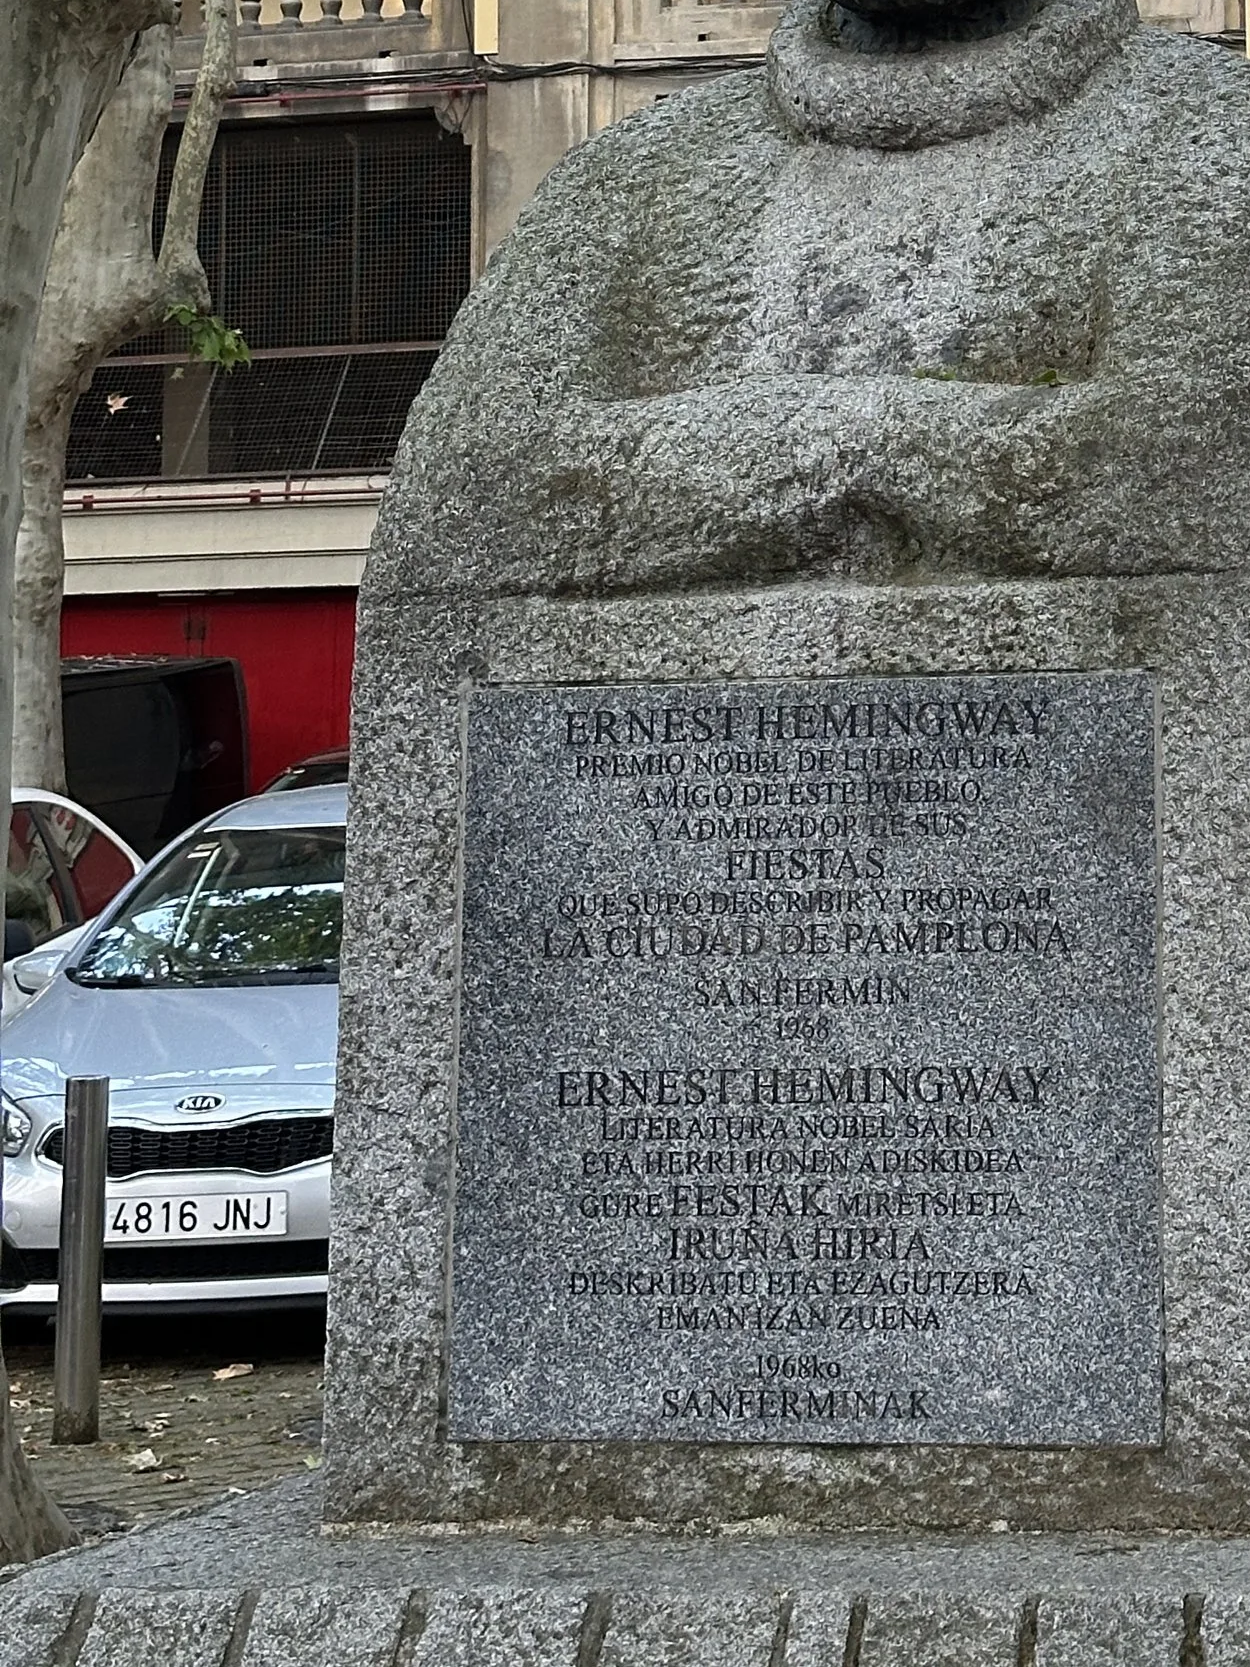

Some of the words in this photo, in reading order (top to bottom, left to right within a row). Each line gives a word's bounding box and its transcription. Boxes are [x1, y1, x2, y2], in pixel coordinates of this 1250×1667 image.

[565, 707, 743, 745] ERNEST
[755, 700, 1050, 741] HEMINGWAY
[575, 752, 686, 778] PREMIO
[694, 750, 789, 775] NOBEL
[798, 749, 834, 773] DE
[842, 746, 1032, 771] LITERATURA
[632, 784, 734, 809] AMIGO
[743, 784, 780, 806] DE
[788, 782, 856, 805] ESTE
[648, 818, 664, 841] Y
[675, 815, 857, 841] ADMIRADOR
[914, 811, 971, 837] SUS
[726, 848, 886, 881] FIESTAS
[558, 893, 620, 921] QUE
[626, 891, 701, 917] SUPO
[709, 888, 862, 916] DESCRIBIR
[869, 889, 890, 912] Y
[900, 886, 1054, 912] PROPAGAR
[540, 926, 593, 959] LA
[605, 924, 763, 958] CIUDAD
[777, 923, 832, 954] DE
[844, 920, 1074, 955] PAMPLONA
[694, 979, 761, 1007] SAN
[775, 1017, 831, 1040] 1968
[557, 1069, 741, 1108] ERNEST
[750, 1066, 1052, 1107] HEMINGWAY
[181, 1096, 216, 1110] KIA
[601, 1116, 788, 1141] LITERATURA
[798, 1115, 896, 1139] NOBEL
[903, 1114, 997, 1139] SARIA
[581, 1151, 635, 1176] ETA
[645, 1150, 736, 1175] HERRI
[745, 1149, 849, 1174] HONEN
[857, 1148, 1025, 1174] ADISKIDEA
[112, 1200, 198, 1234] 4816
[213, 1197, 272, 1231] JNJ
[579, 1192, 664, 1219] GURE
[671, 1184, 831, 1218] FESTAK
[669, 1219, 800, 1261] IRUÑA
[813, 1226, 933, 1261] HIRIA
[568, 1270, 758, 1296] DESKRIBATU
[766, 1271, 823, 1295] ETA
[831, 1271, 1034, 1296] EZAGUTZERA
[656, 1305, 746, 1331] EMAN
[752, 1305, 828, 1331] IZAN
[837, 1305, 944, 1331] ZUENA
[755, 1353, 842, 1380] 1968ko
[660, 1389, 934, 1420] SANFERMINAK
